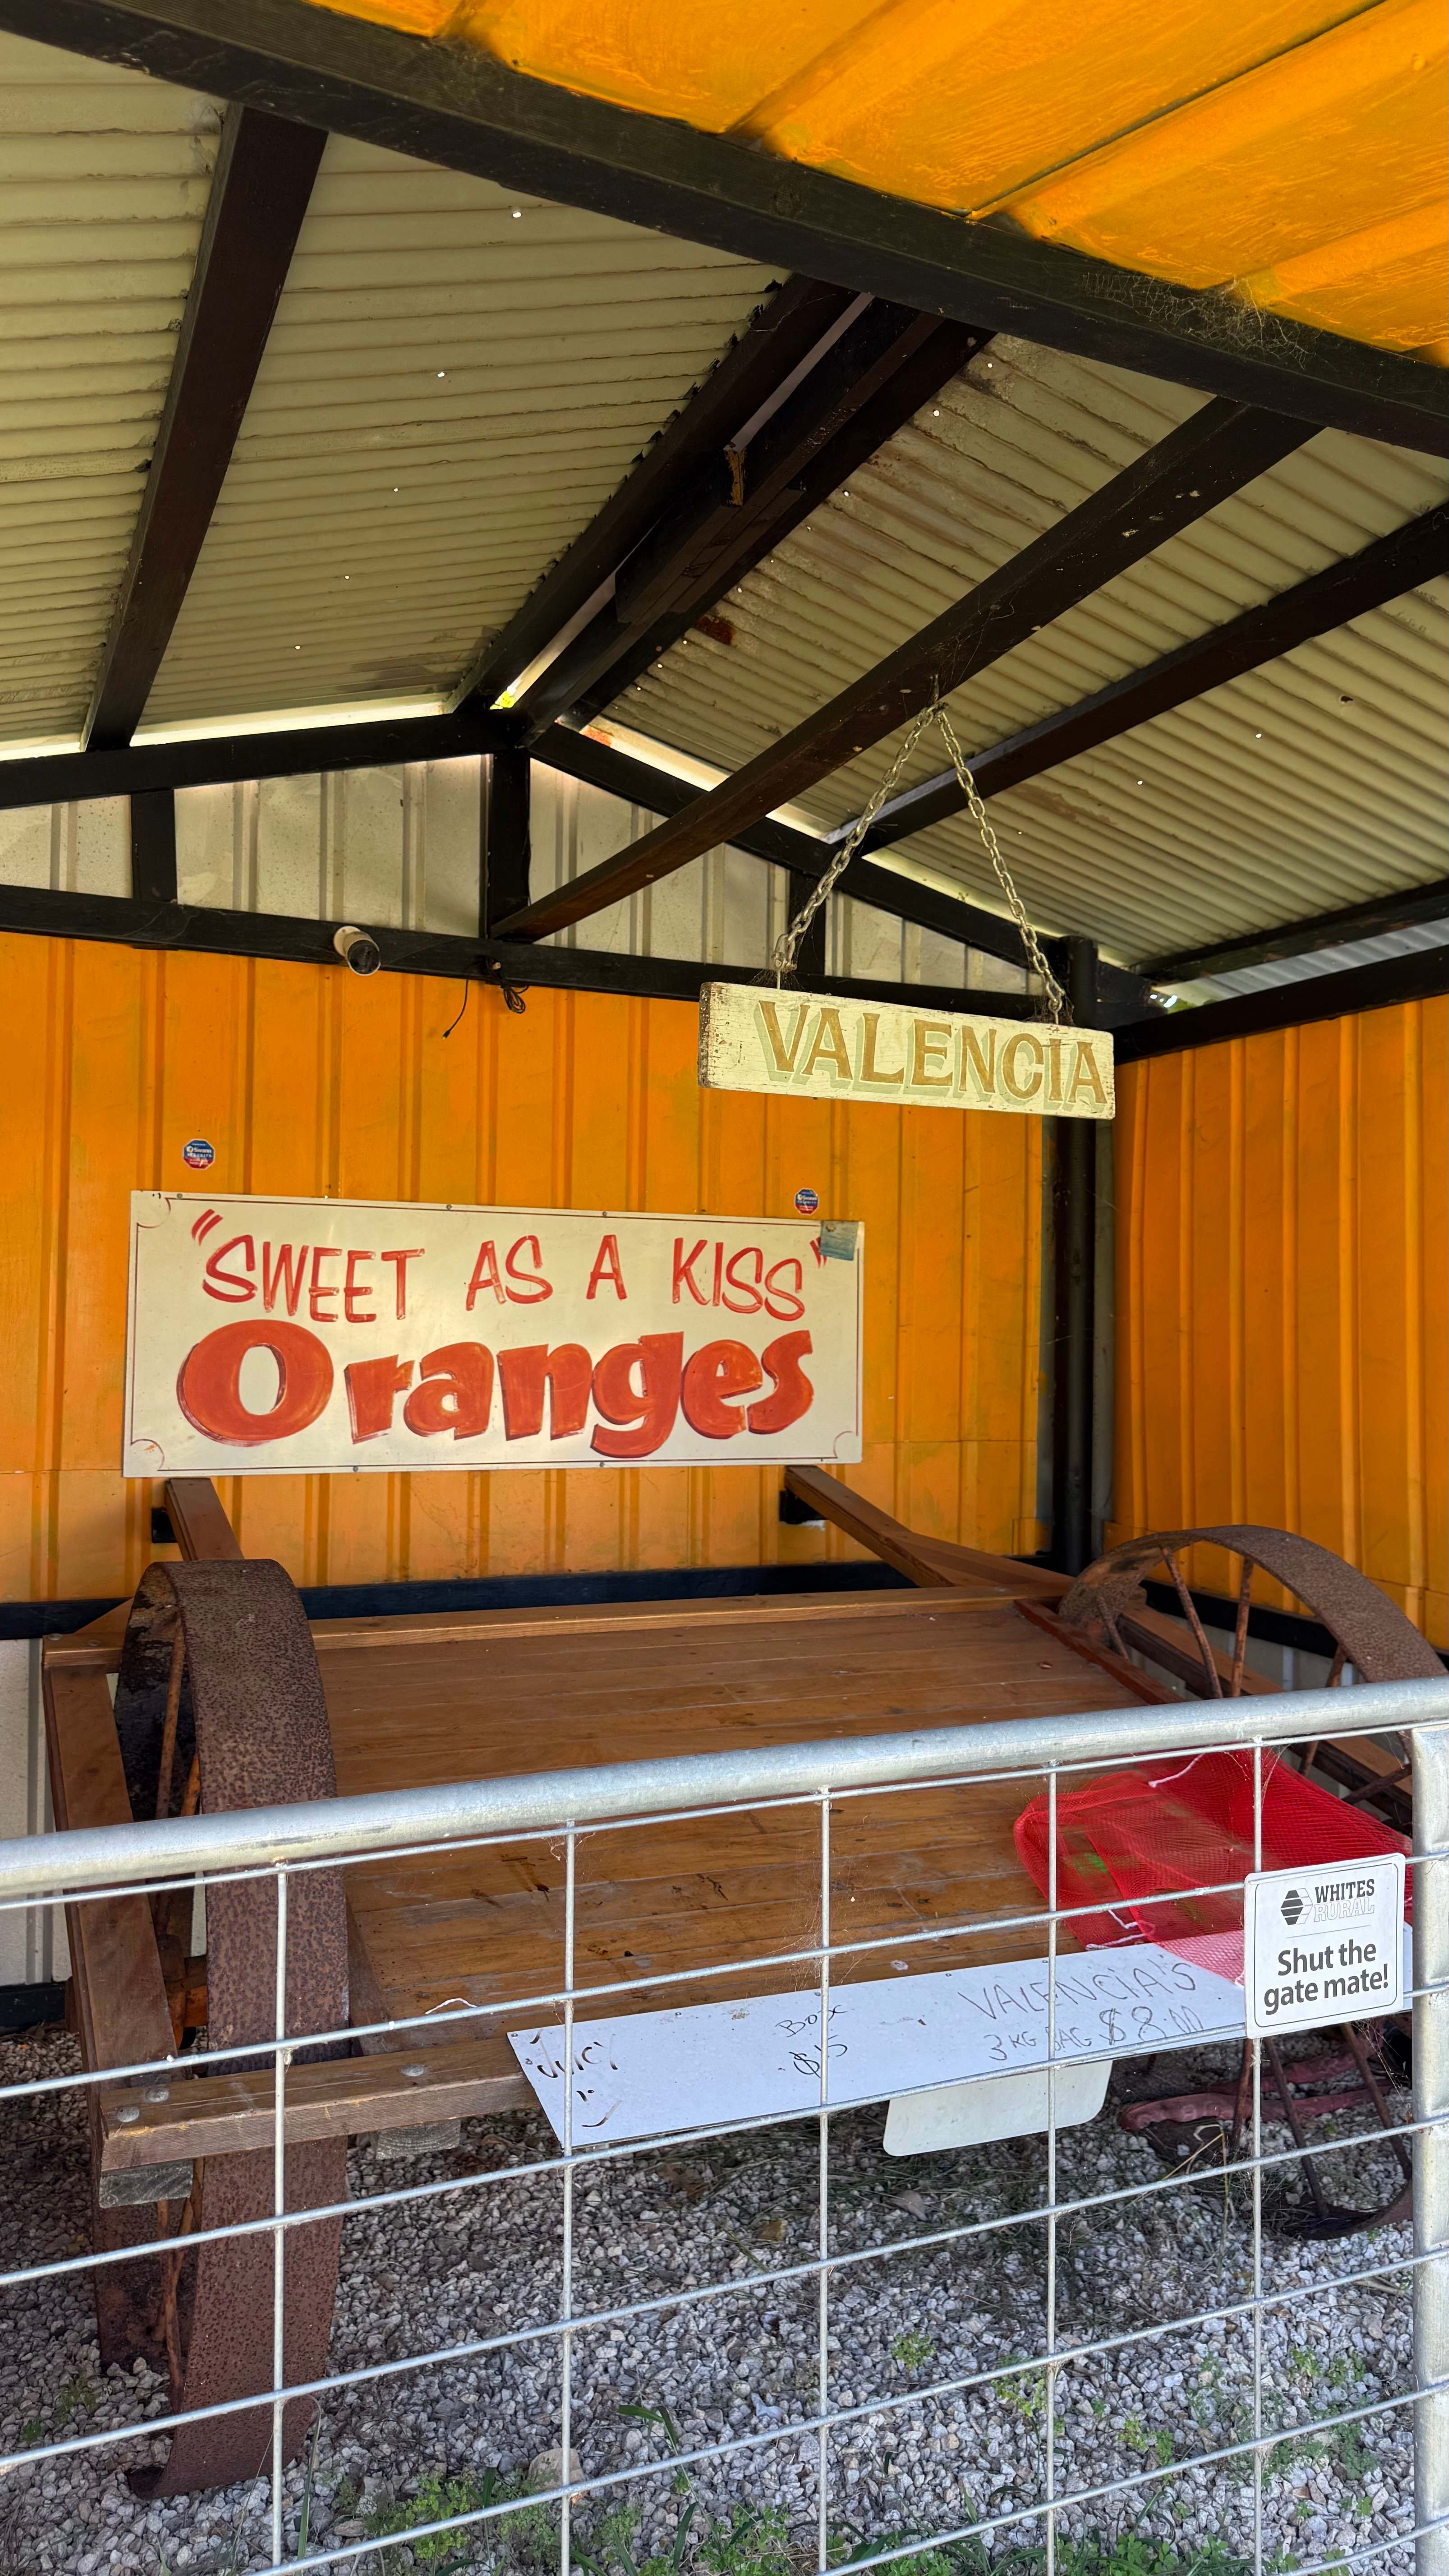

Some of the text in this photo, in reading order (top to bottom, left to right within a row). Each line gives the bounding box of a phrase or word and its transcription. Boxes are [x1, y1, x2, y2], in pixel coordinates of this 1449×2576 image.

[754, 1000, 1107, 1110] VALENCIA
[466, 1234, 553, 1311] AS
[586, 1234, 627, 1301] A
[176, 1319, 814, 1458] Oranges
[1313, 1897, 1375, 1923] RURAL
[1315, 1879, 1375, 1904] WHITES
[1278, 1939, 1377, 1976] Shut the
[1264, 1963, 1389, 2015] gate mate!
